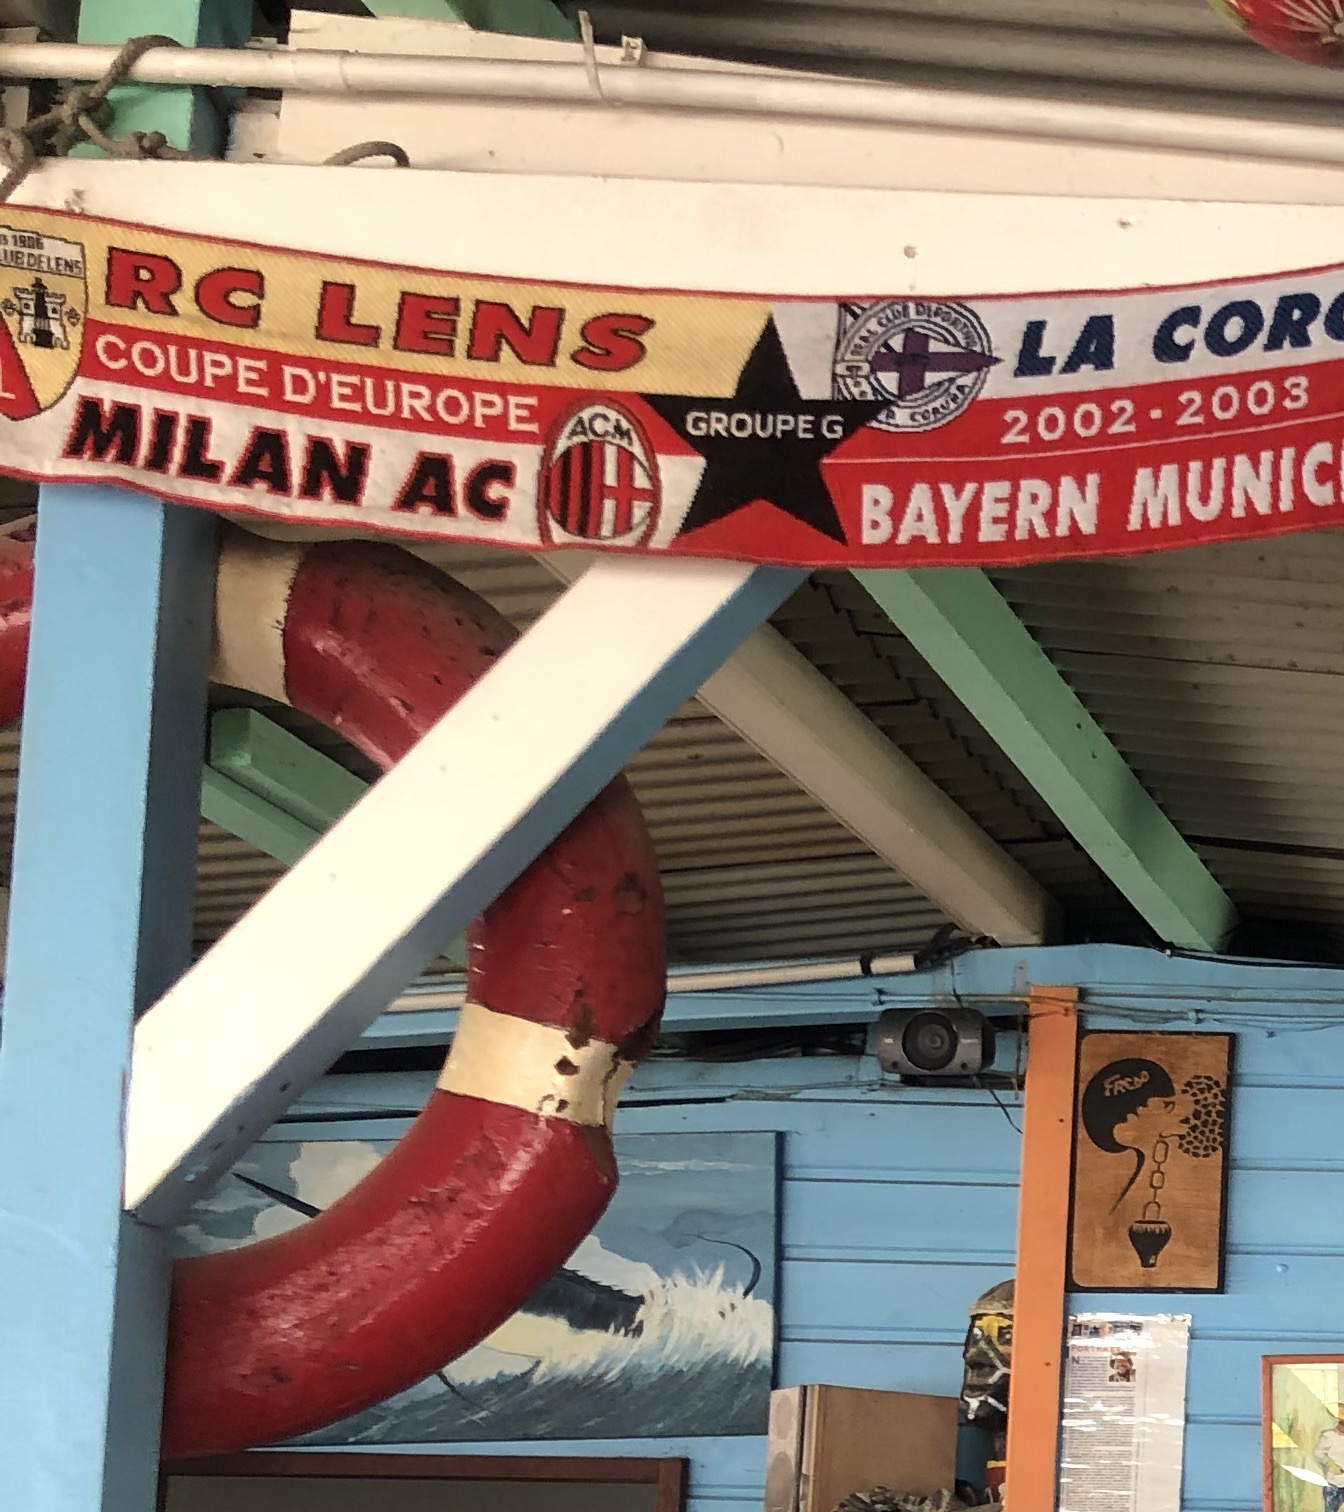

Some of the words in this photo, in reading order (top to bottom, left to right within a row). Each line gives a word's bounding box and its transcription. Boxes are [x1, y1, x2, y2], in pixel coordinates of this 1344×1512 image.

[104, 246, 267, 331] RC
[313, 279, 657, 374] LENS
[1012, 313, 1115, 383] LA
[94, 332, 271, 399] COUPE
[282, 363, 542, 436] D'EUROPE
[685, 411, 815, 440] GROUPE
[820, 413, 845, 440] G
[62, 397, 373, 511] MILAN
[390, 449, 520, 523] AC
[564, 406, 636, 448] ACM
[859, 463, 1102, 548] BAYERN
